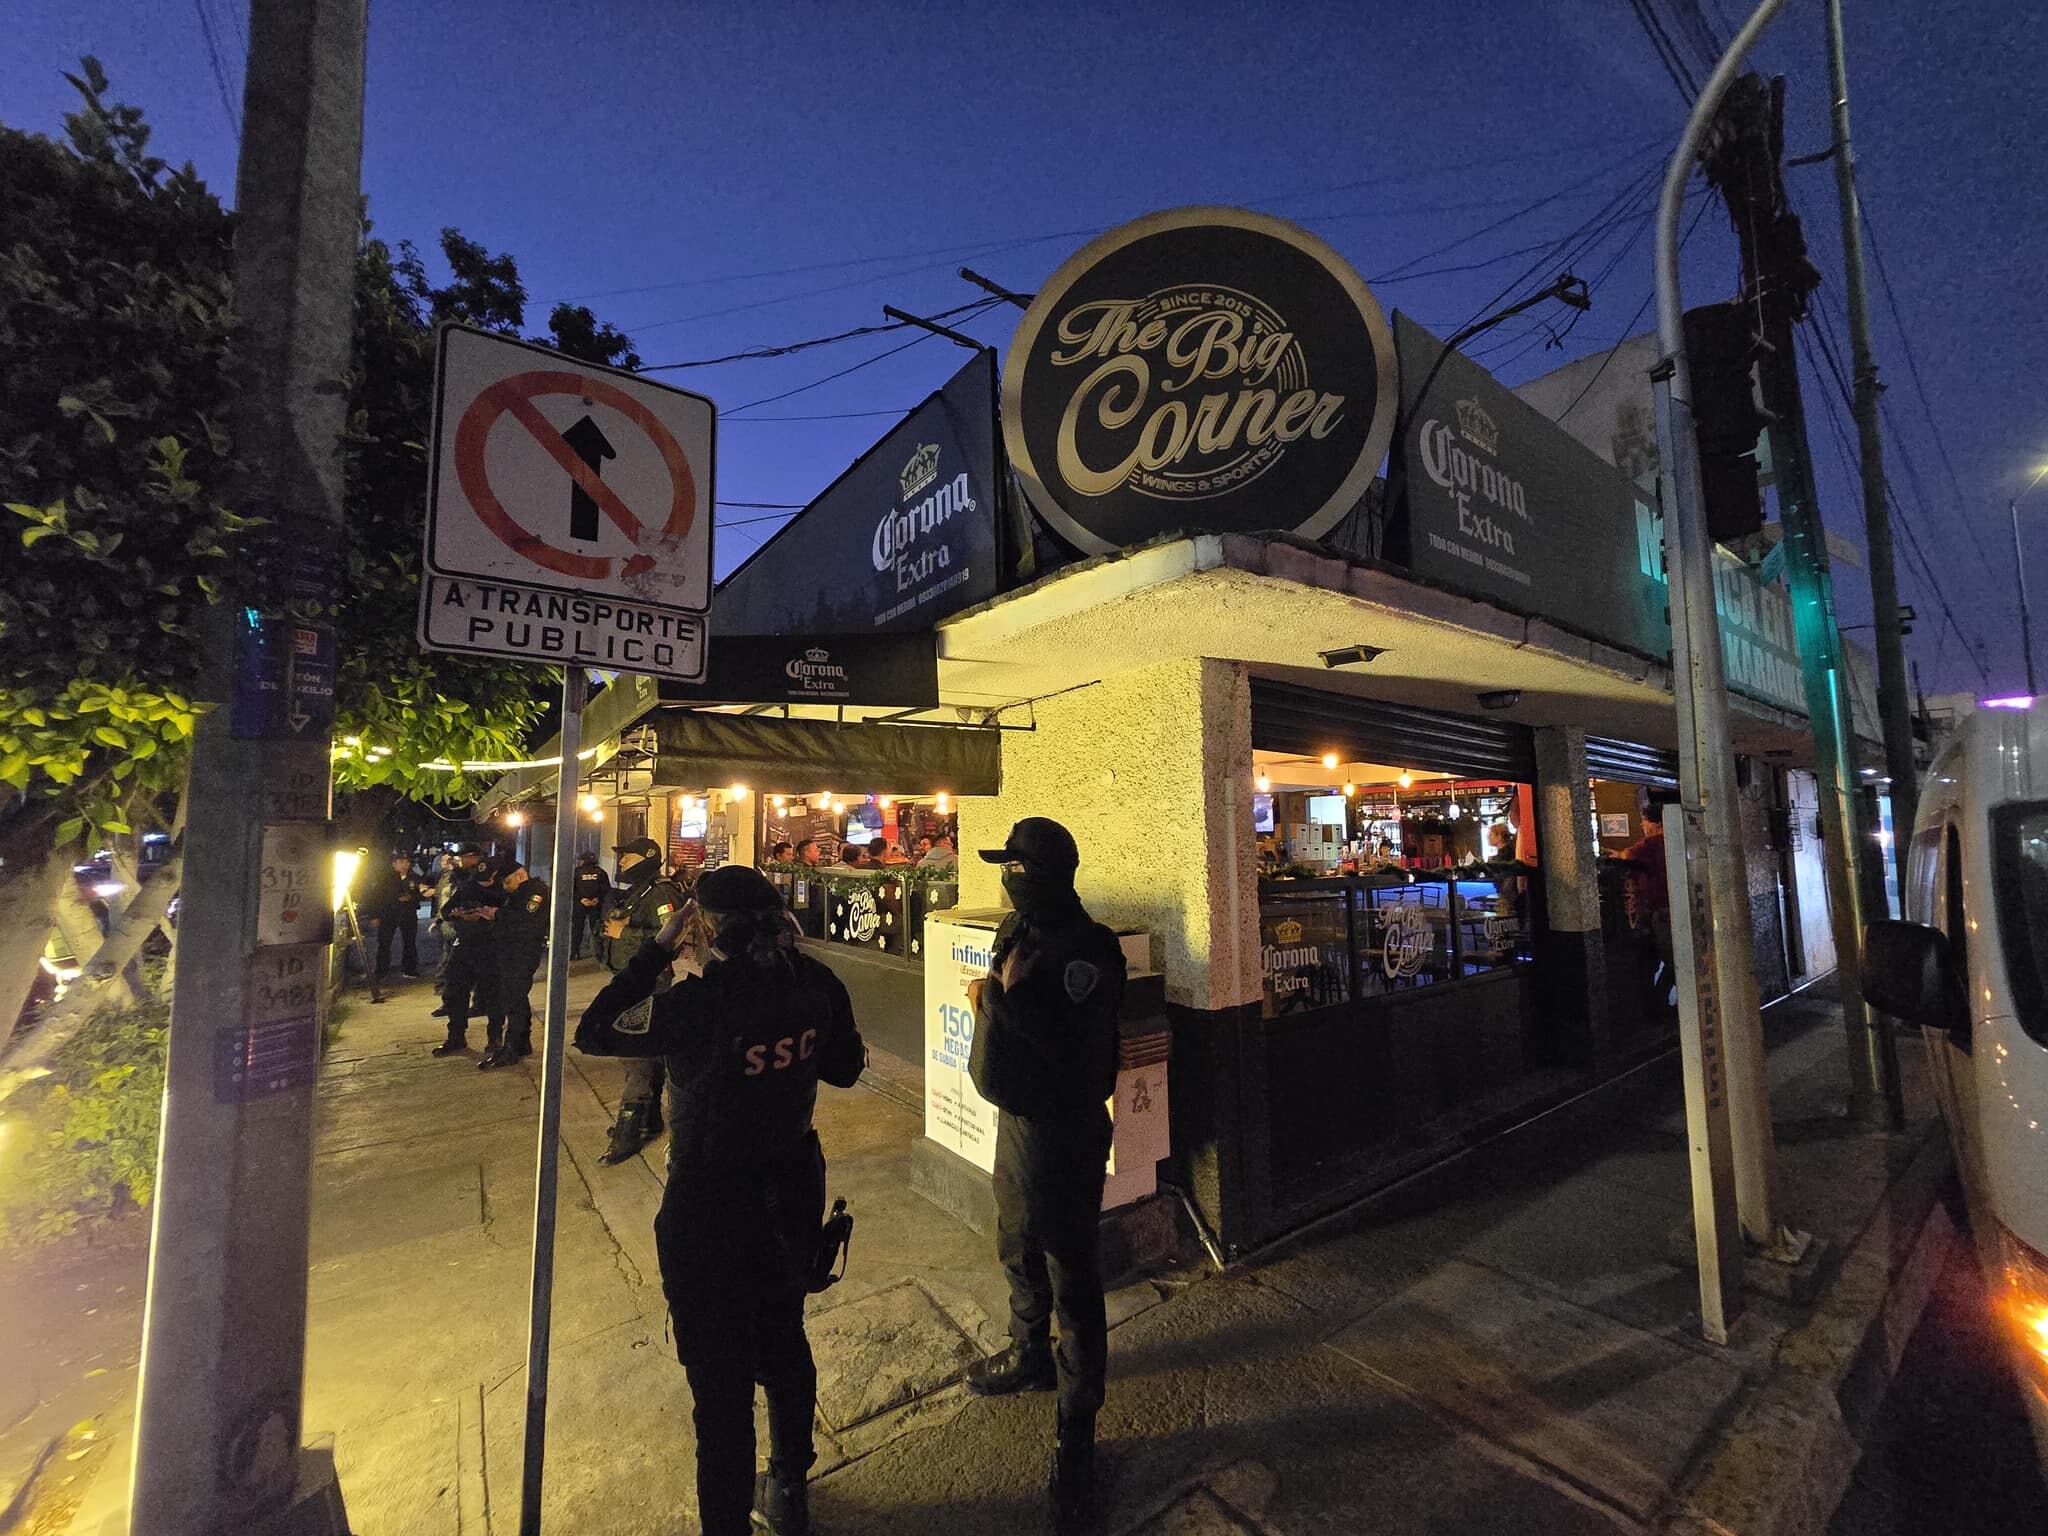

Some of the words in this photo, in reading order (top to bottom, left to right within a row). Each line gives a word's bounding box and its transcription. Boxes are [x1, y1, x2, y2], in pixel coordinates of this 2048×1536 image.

[1160, 292, 1213, 311] SINCE
[1214, 294, 1254, 317] 2015
[1050, 297, 1168, 366] The
[1161, 309, 1294, 393] Big
[1056, 354, 1345, 498] Corner
[1142, 473, 1196, 493] WINGS
[1198, 480, 1211, 491] &
[1212, 446, 1272, 488] SPORTS
[1420, 419, 1528, 520] Corona
[872, 472, 971, 573] Corona
[1456, 490, 1516, 556] Extra
[896, 543, 950, 593] Extra
[443, 581, 465, 608] A
[477, 586, 696, 642] TRANSPORTE
[469, 617, 674, 667] PUBLICO
[785, 659, 845, 681] Corona
[804, 677, 835, 690] Extra
[849, 902, 881, 938] Corner
[860, 891, 876, 913] Big
[952, 942, 992, 968] infinit
[1262, 944, 1319, 980] Corona
[1384, 924, 1435, 979] Corner
[1274, 973, 1310, 993] Extra
[939, 1003, 973, 1042] 150
